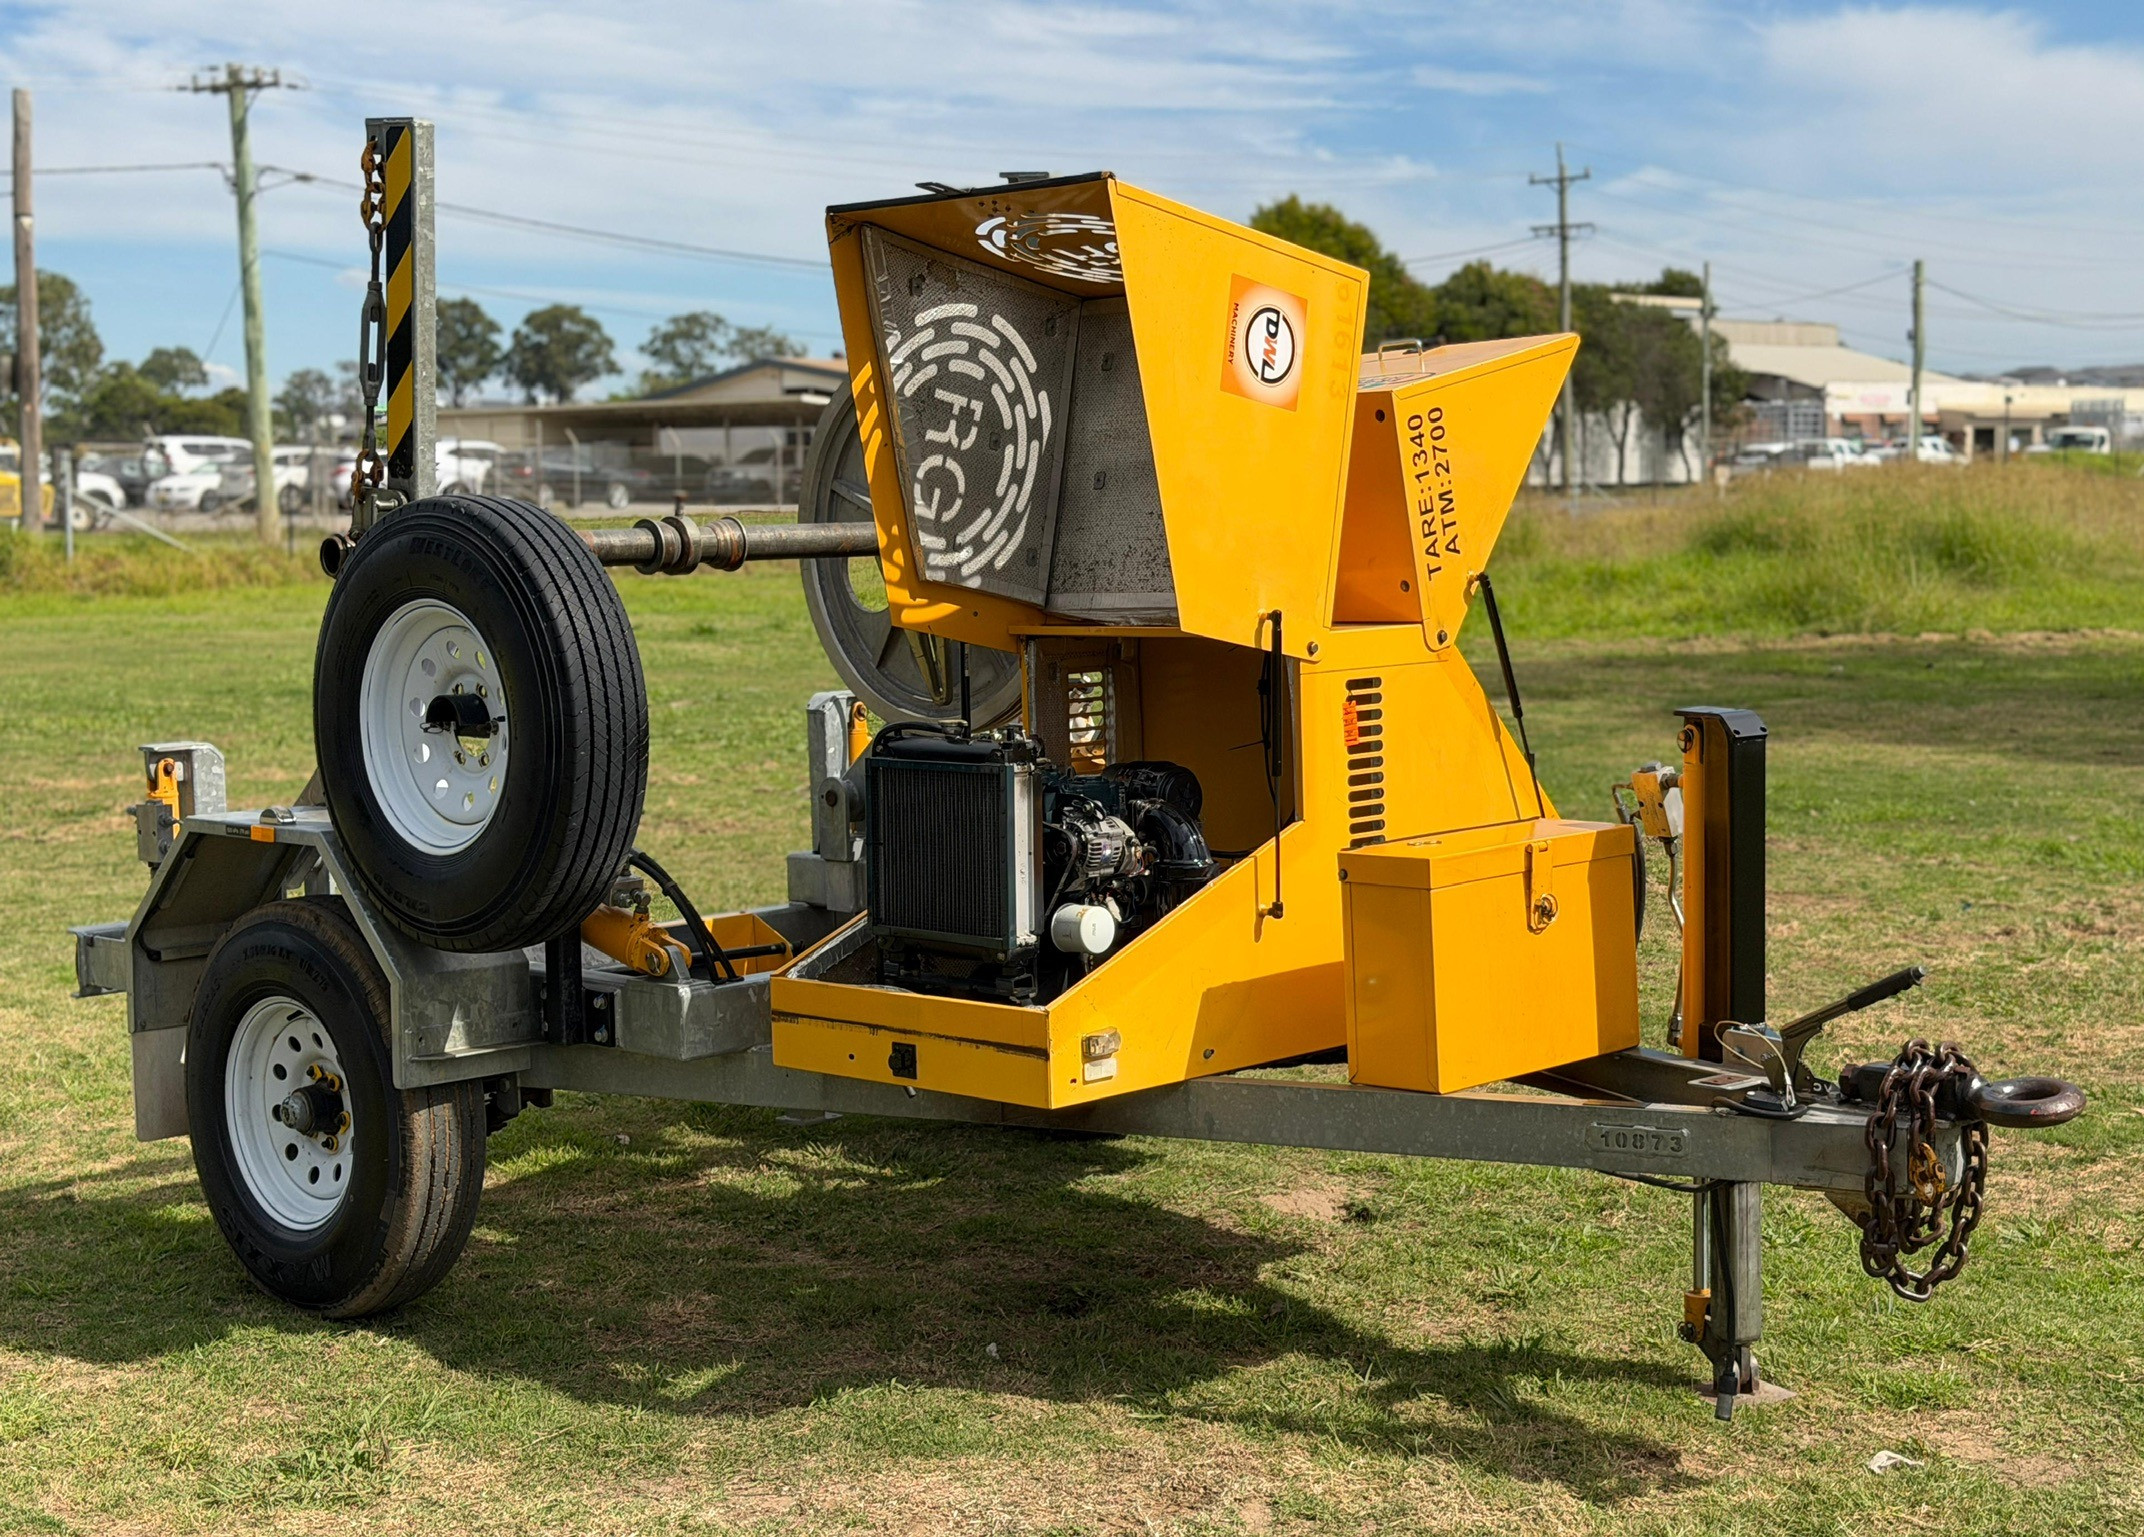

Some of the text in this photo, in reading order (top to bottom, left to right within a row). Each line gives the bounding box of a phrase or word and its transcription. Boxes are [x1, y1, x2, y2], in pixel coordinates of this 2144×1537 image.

[1228, 302, 1239, 365] MACHINERY
[1256, 308, 1285, 384] DWL
[1407, 414, 1442, 582] TARE:1340
[1427, 406, 1461, 555] ATM:2700
[1600, 1130, 1683, 1153] 10873
